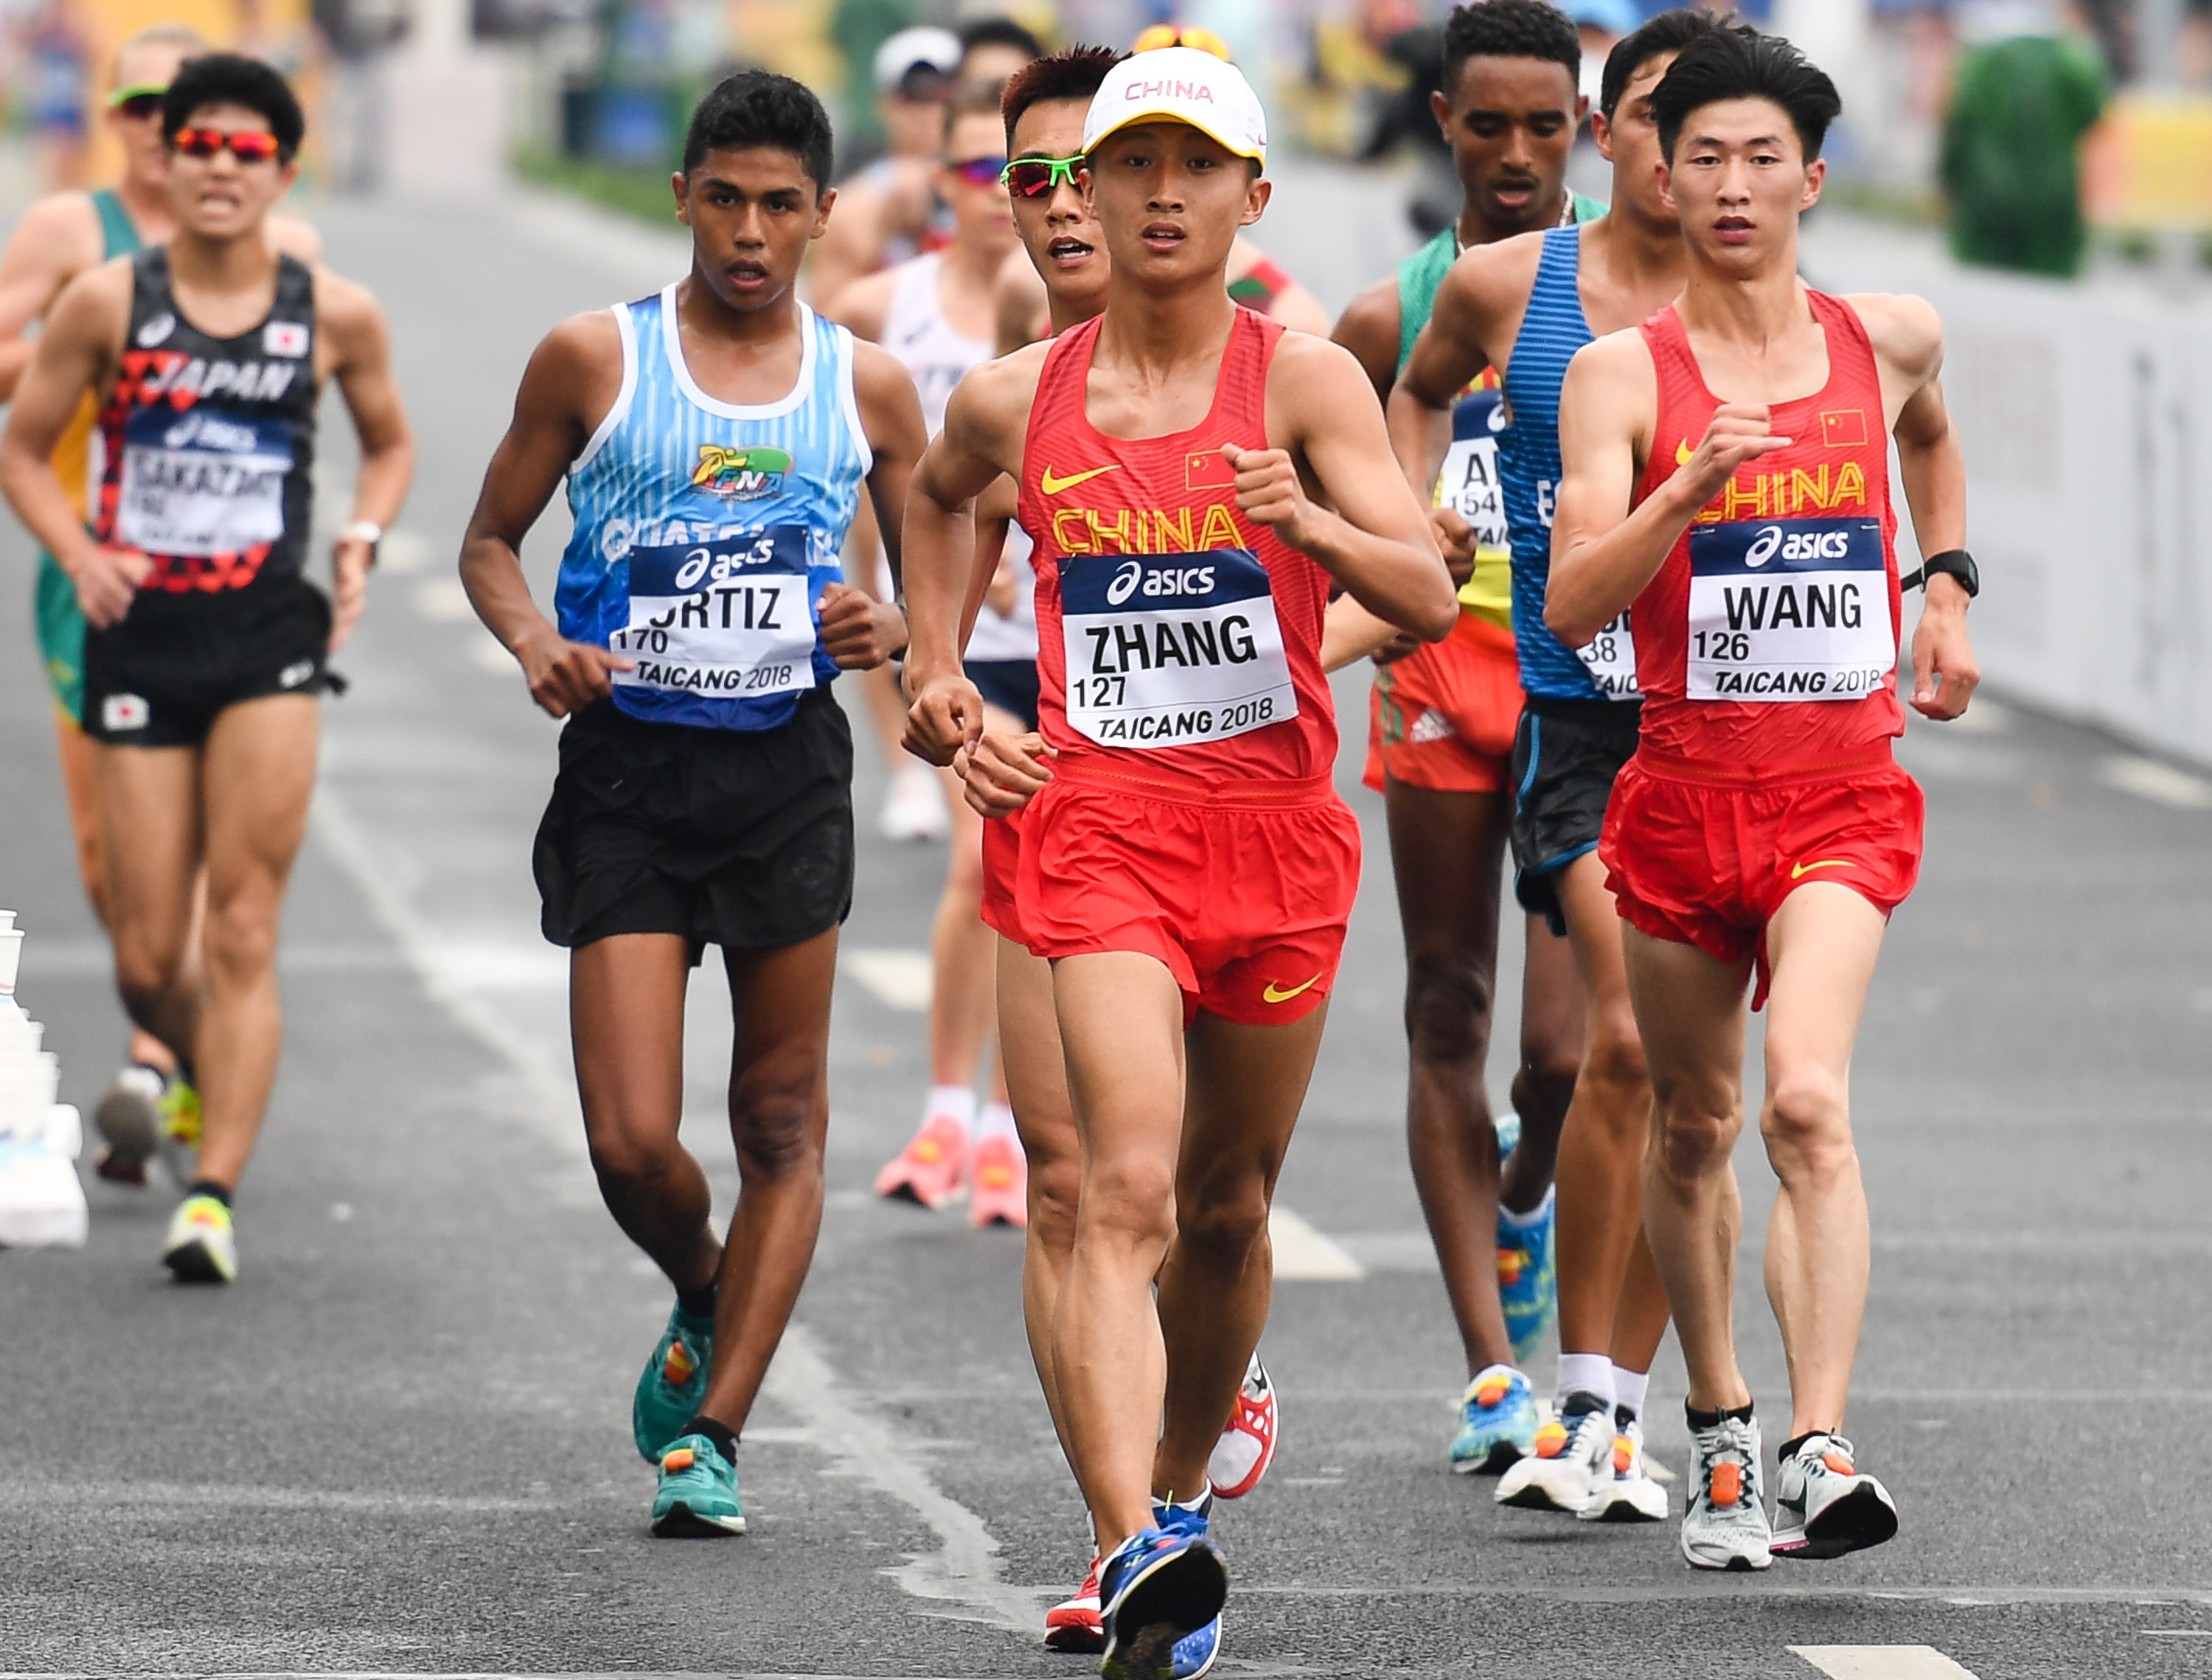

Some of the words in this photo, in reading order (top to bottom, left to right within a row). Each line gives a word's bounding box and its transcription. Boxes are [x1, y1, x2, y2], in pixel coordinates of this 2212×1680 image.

[1125, 80, 1214, 104] CHINA
[145, 358, 295, 400] JAPAN
[1053, 504, 1246, 554] CHINA
[1781, 532, 1848, 560] asics
[1143, 566, 1215, 596] asics
[1724, 583, 1862, 631] WANG
[617, 628, 669, 654] 170
[1085, 615, 1258, 674] ZHANG
[1694, 631, 1749, 661] 126
[636, 661, 741, 690] TAICANG
[745, 665, 793, 690] 2018
[1714, 670, 1827, 693] TAICANG
[1832, 669, 1880, 693] 2018
[1073, 676, 1126, 707] 127
[1097, 709, 1213, 740] TAICANG
[1220, 697, 1273, 732] 2018
